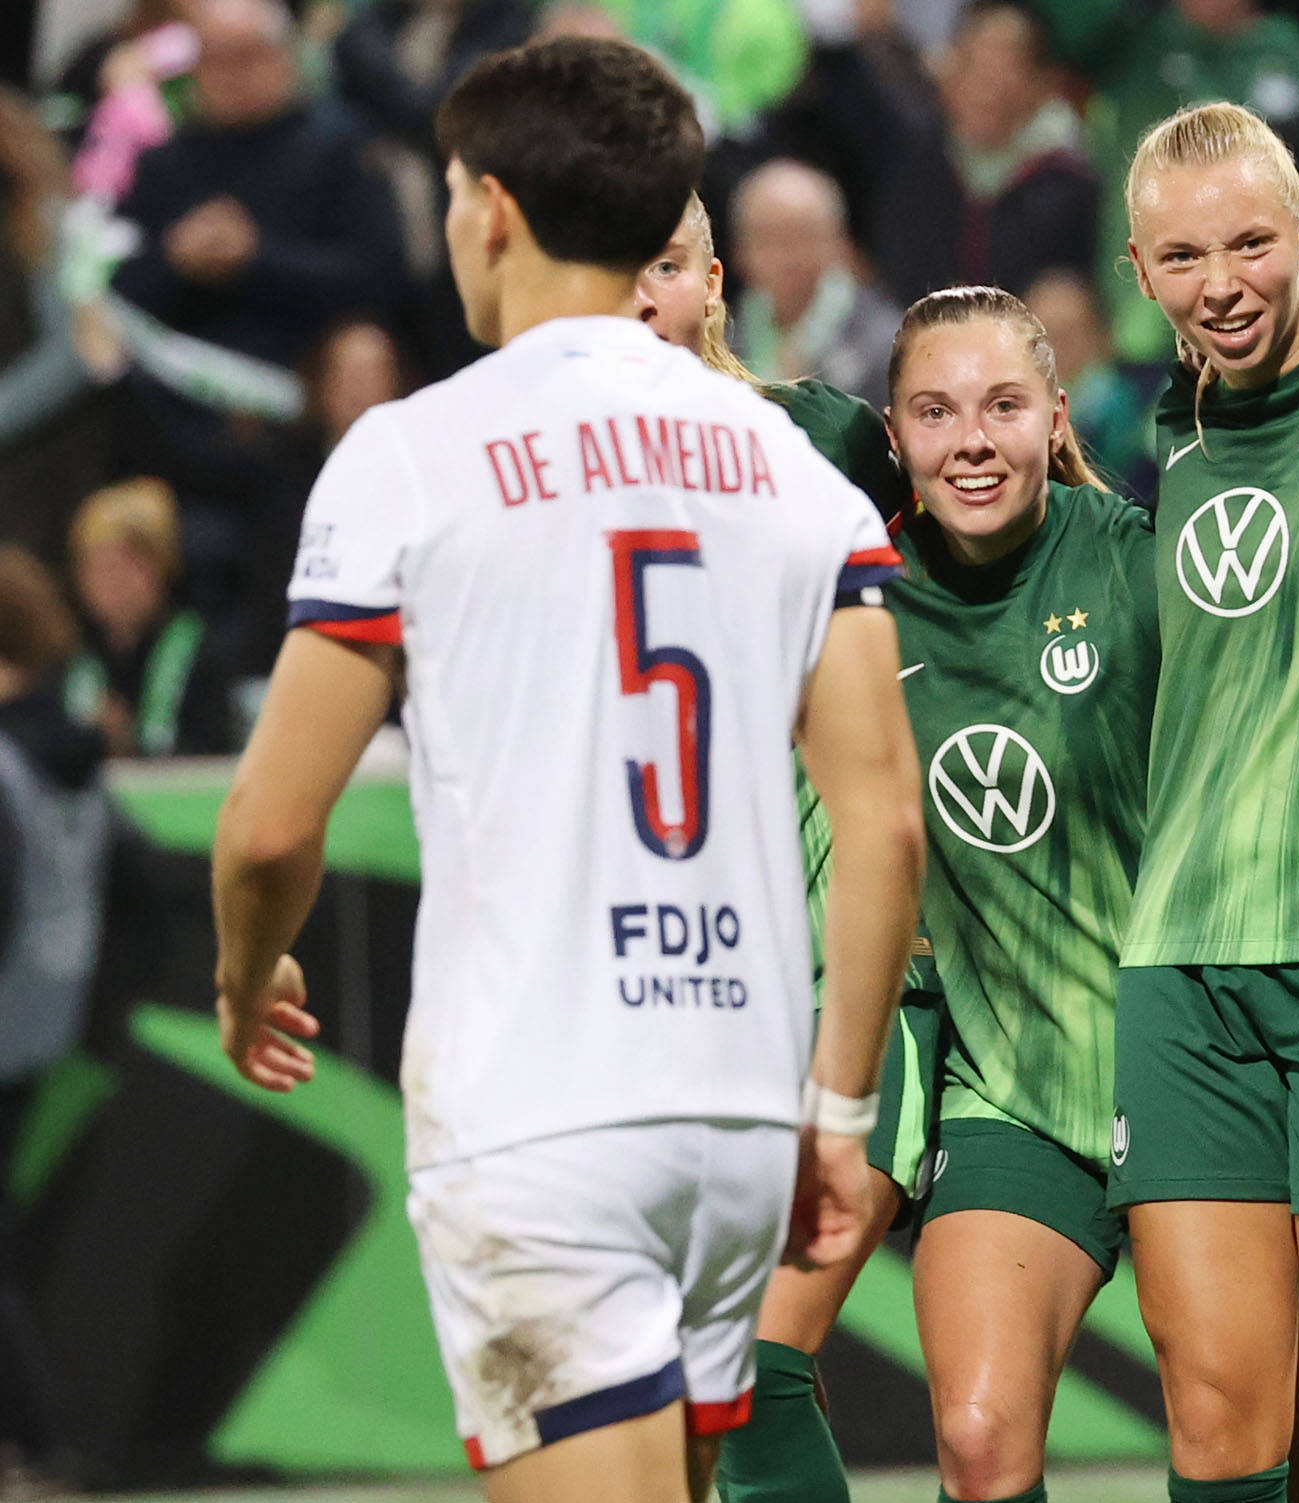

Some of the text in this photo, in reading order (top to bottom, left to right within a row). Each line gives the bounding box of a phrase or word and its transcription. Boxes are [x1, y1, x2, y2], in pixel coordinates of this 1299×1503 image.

[486, 415, 779, 507] DE ALMEIDA
[603, 529, 711, 861] 5
[611, 903, 740, 966] FDJO
[618, 976, 748, 1008] UNITED
